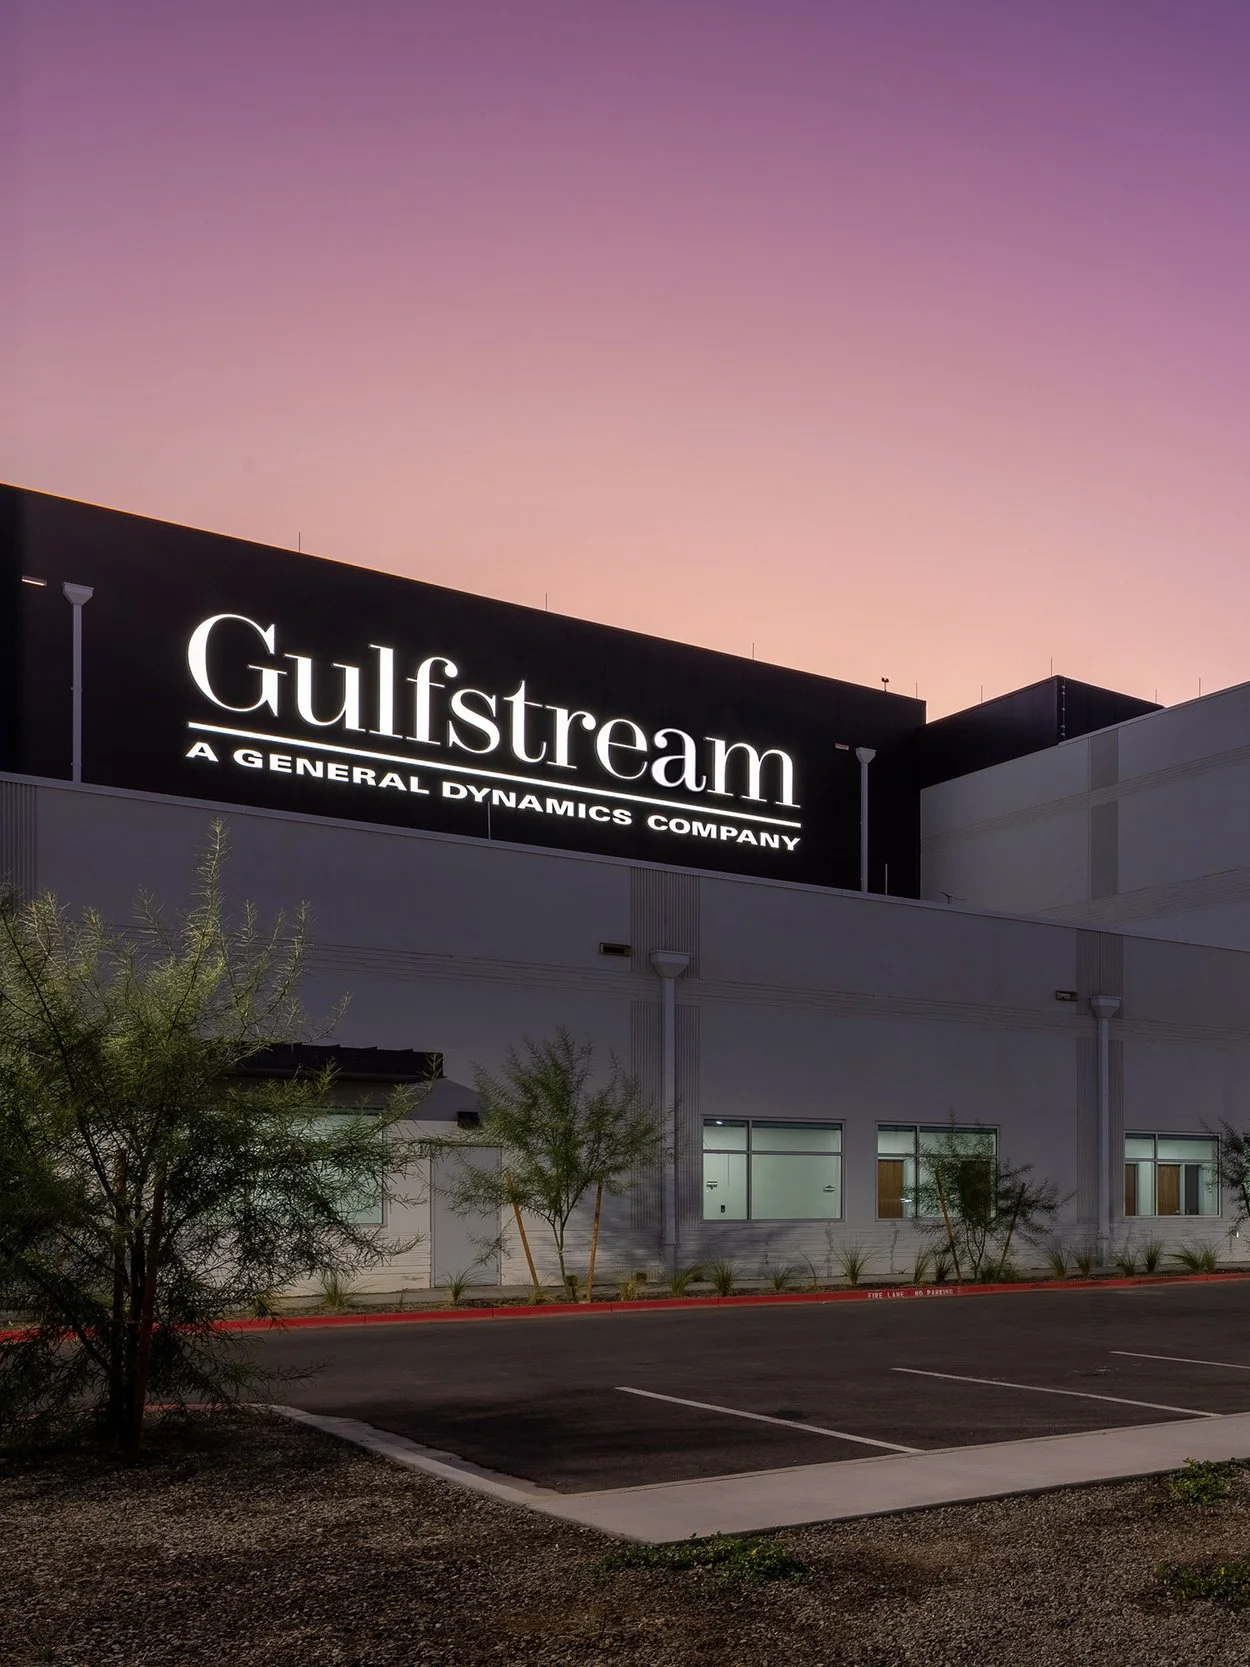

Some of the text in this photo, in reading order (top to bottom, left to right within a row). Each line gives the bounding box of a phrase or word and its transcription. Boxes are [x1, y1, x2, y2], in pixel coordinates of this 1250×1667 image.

[187, 613, 801, 809] Gulfstream
[185, 741, 802, 852] A GENERAL DYNAMICS COMPANY
[867, 1292, 883, 1300] FIRE
[926, 1288, 954, 1296] PARKING
